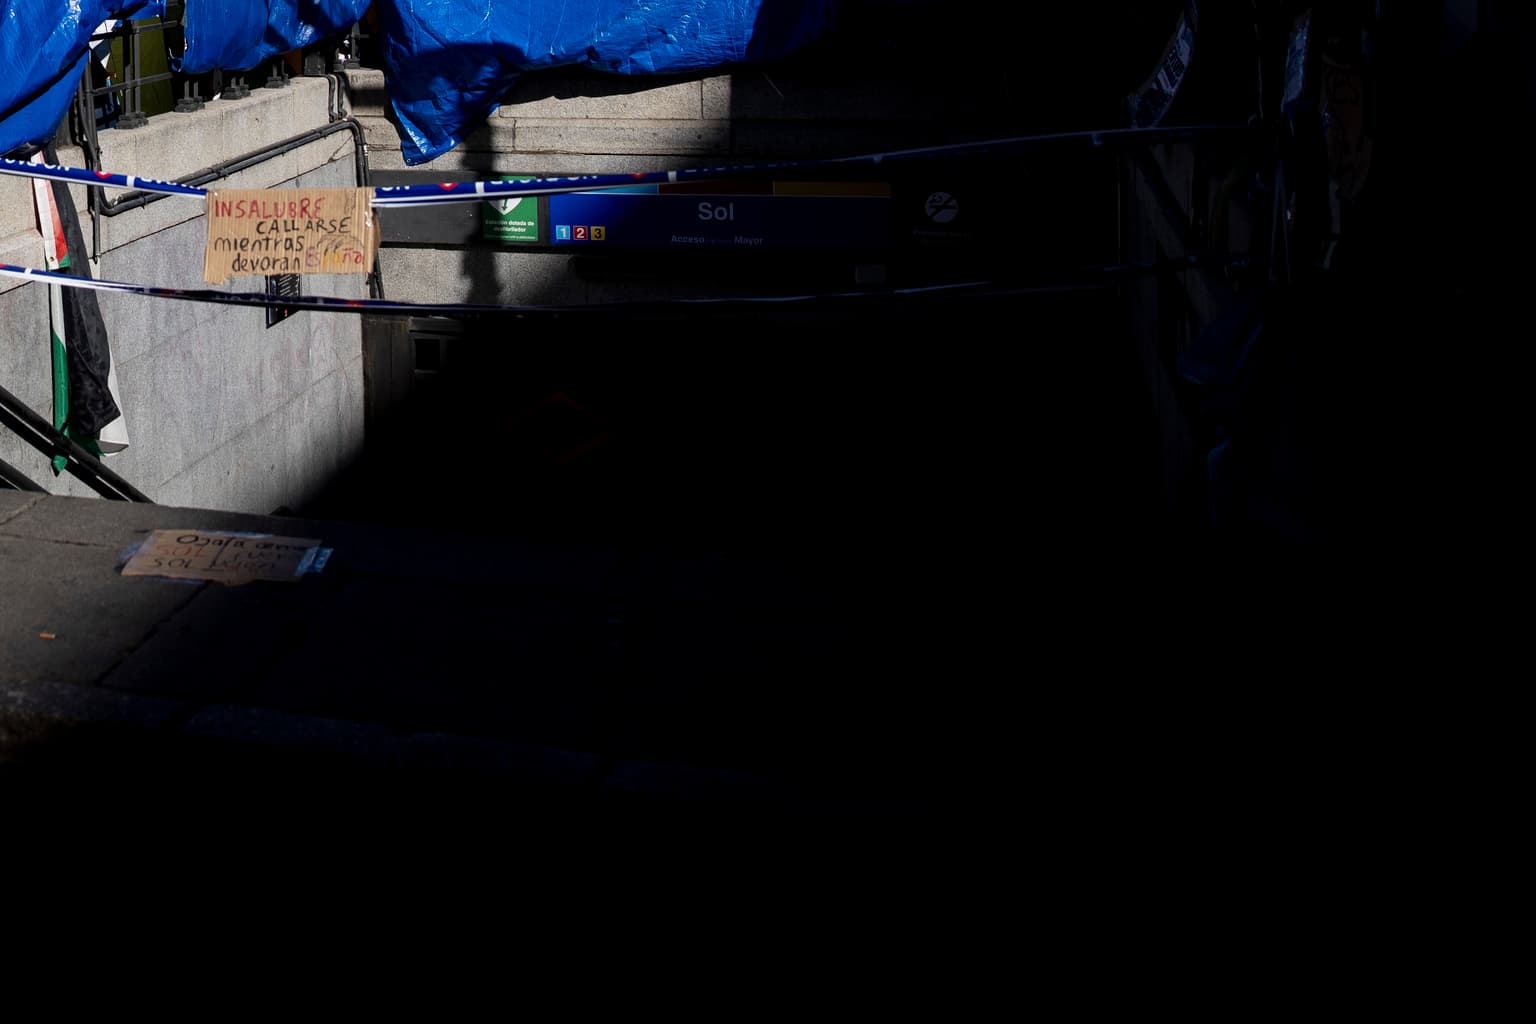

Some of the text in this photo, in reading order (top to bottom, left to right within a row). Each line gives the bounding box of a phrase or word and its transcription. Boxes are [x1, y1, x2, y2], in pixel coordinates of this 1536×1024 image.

[215, 196, 326, 220] INSALUBRE
[697, 201, 736, 222] Sol
[214, 235, 304, 252] mientras
[232, 252, 301, 273] devoran
